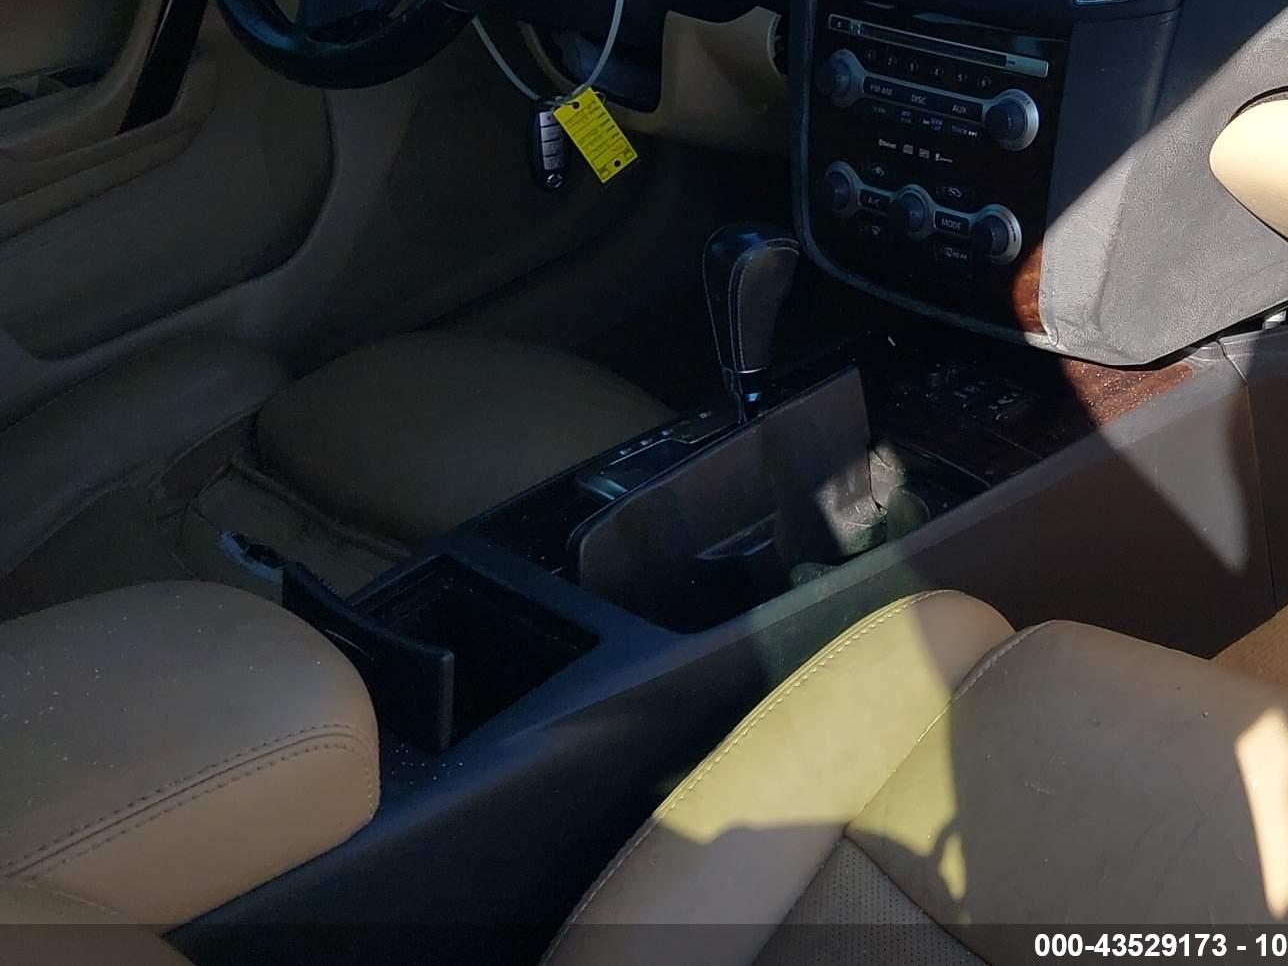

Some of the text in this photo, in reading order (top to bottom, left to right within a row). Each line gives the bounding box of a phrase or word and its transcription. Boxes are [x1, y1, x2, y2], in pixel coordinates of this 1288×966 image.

[911, 94, 928, 106] DISC
[951, 104, 968, 115] AUX
[941, 218, 962, 231] MODE
